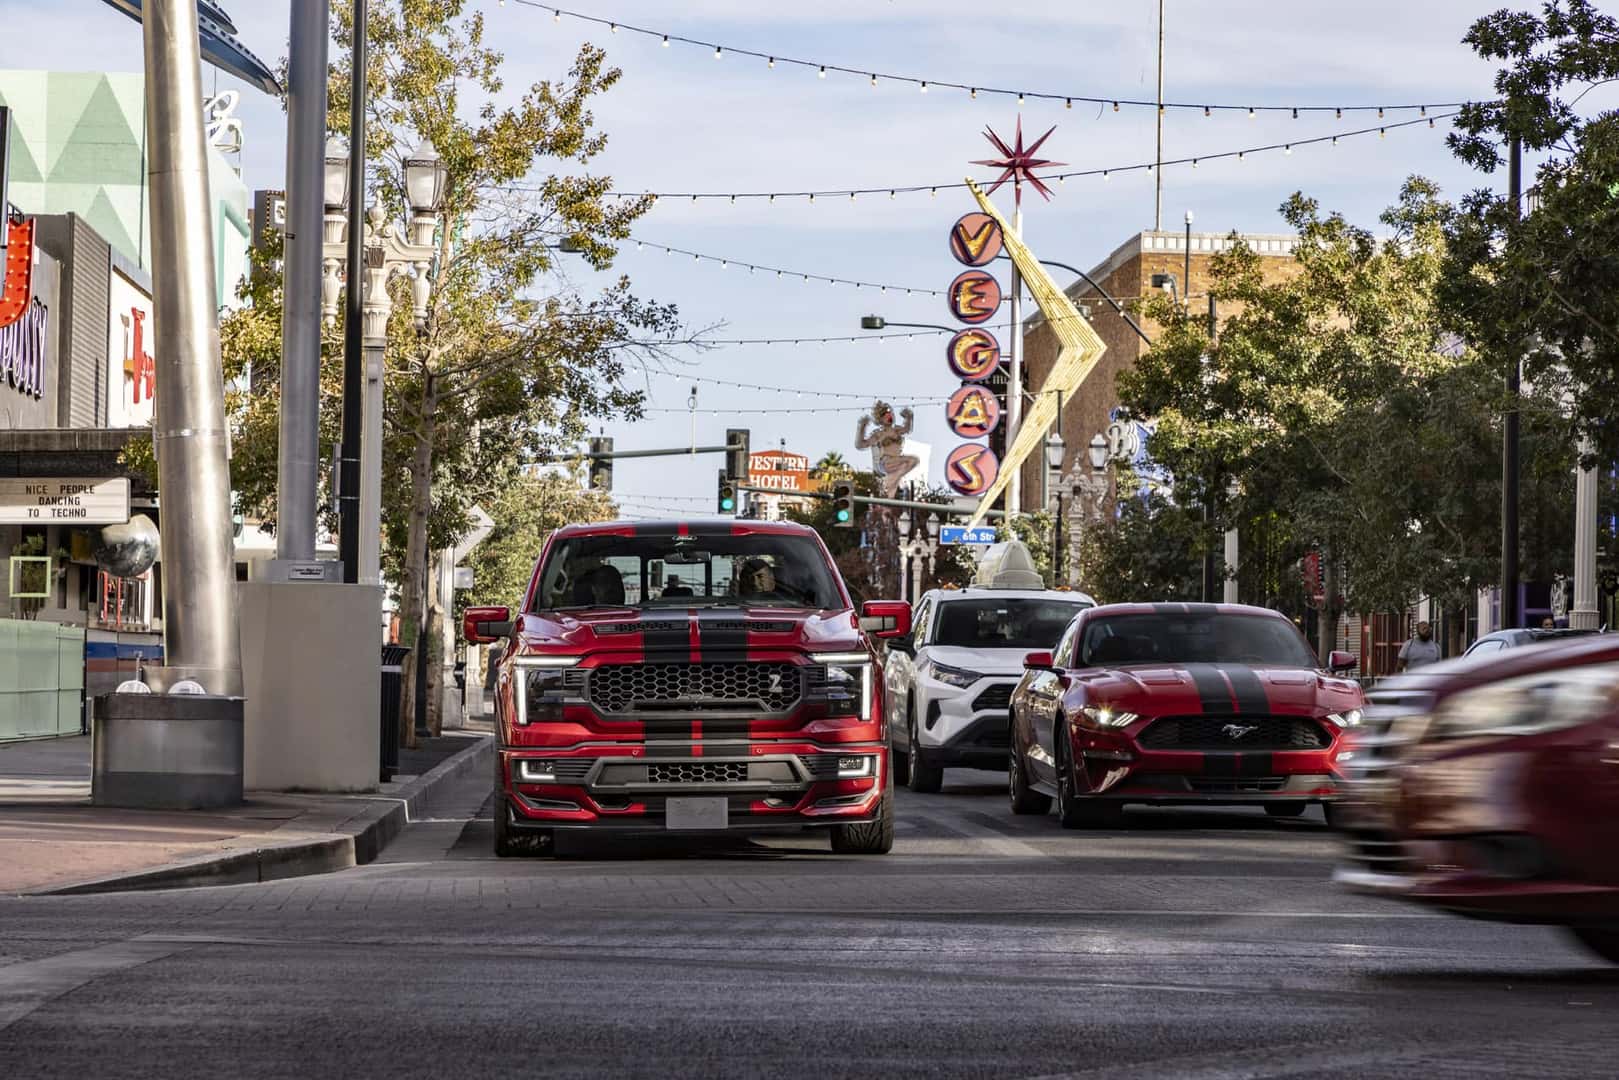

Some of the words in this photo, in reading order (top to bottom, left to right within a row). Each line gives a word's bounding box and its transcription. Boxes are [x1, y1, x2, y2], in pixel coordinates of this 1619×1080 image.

[949, 219, 998, 493] VEGAS
[749, 456, 808, 471] ESTRN
[750, 474, 799, 489] HOTEL
[25, 485, 48, 494] NICE
[60, 485, 95, 494] PEOPLE
[38, 497, 80, 506] DANCING
[28, 508, 39, 517] TO
[51, 508, 87, 517] TECHNO
[962, 531, 977, 541] 6th
